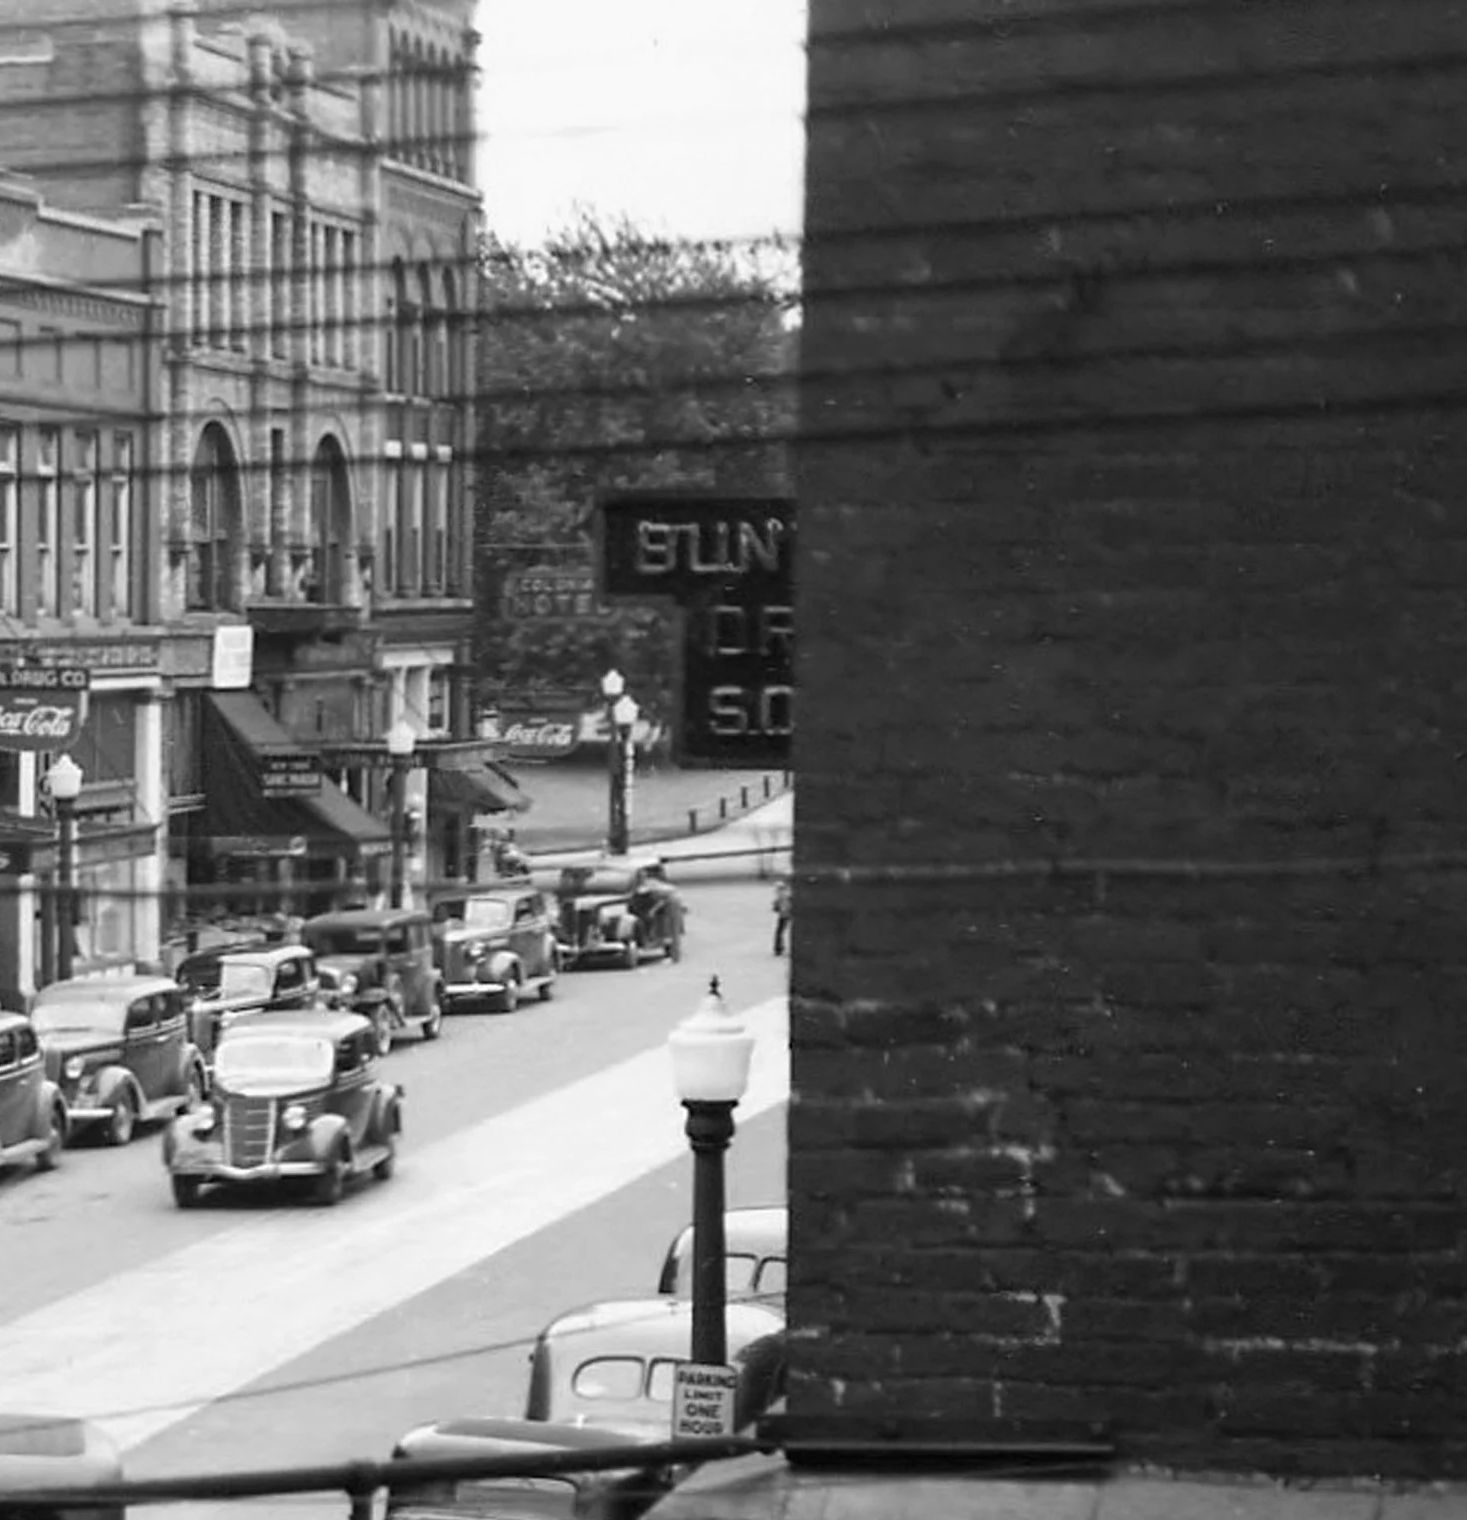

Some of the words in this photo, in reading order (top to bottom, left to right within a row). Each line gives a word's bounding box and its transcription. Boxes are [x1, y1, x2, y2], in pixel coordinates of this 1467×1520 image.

[678, 1370, 737, 1389] PARKING
[684, 1389, 724, 1400] LIMIT
[686, 1403, 722, 1419] ONE
